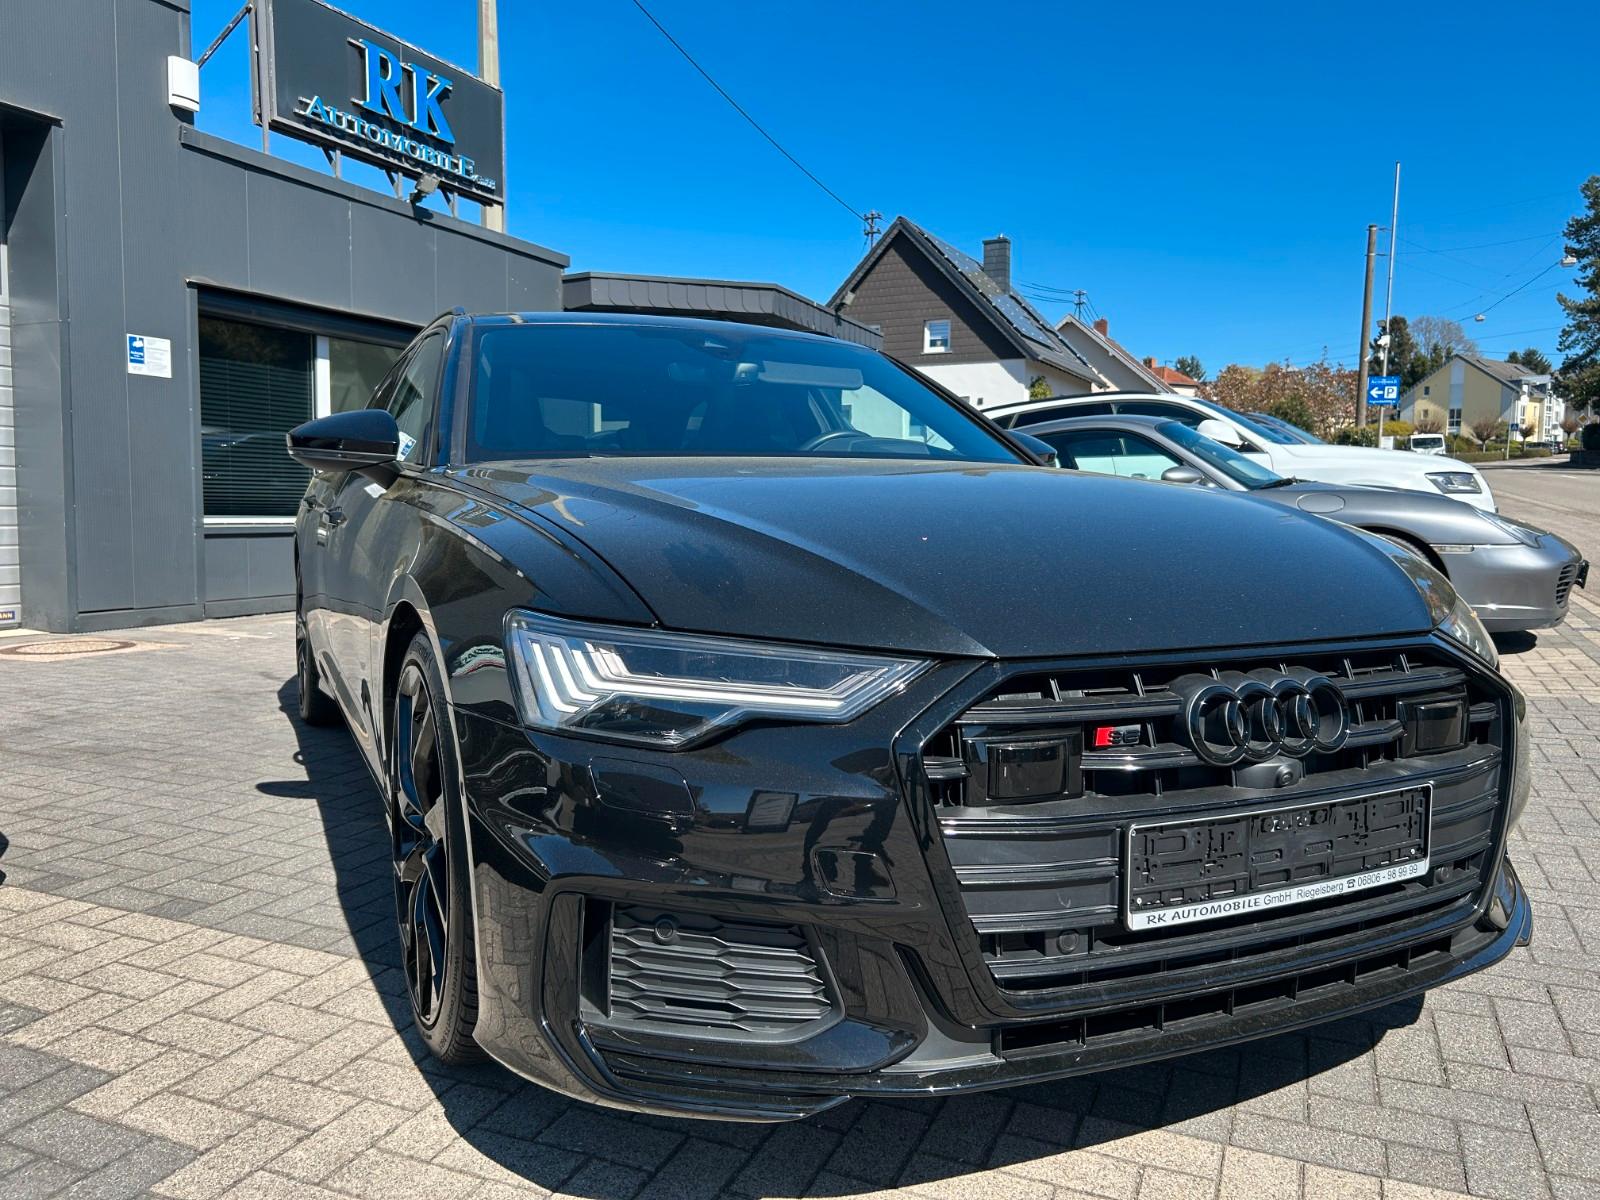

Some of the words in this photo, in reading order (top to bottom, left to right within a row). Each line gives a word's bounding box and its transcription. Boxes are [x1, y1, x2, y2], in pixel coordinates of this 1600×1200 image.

[347, 38, 455, 143] RK
[1146, 913, 1167, 925] RK
[1171, 896, 1261, 921] AUTOMOBILE
[1263, 891, 1292, 905] GmbH
[1296, 881, 1344, 899] Riegelsberg
[1357, 871, 1381, 887] 06806
[1398, 866, 1408, 877] 99
[1408, 864, 1418, 875] 99
